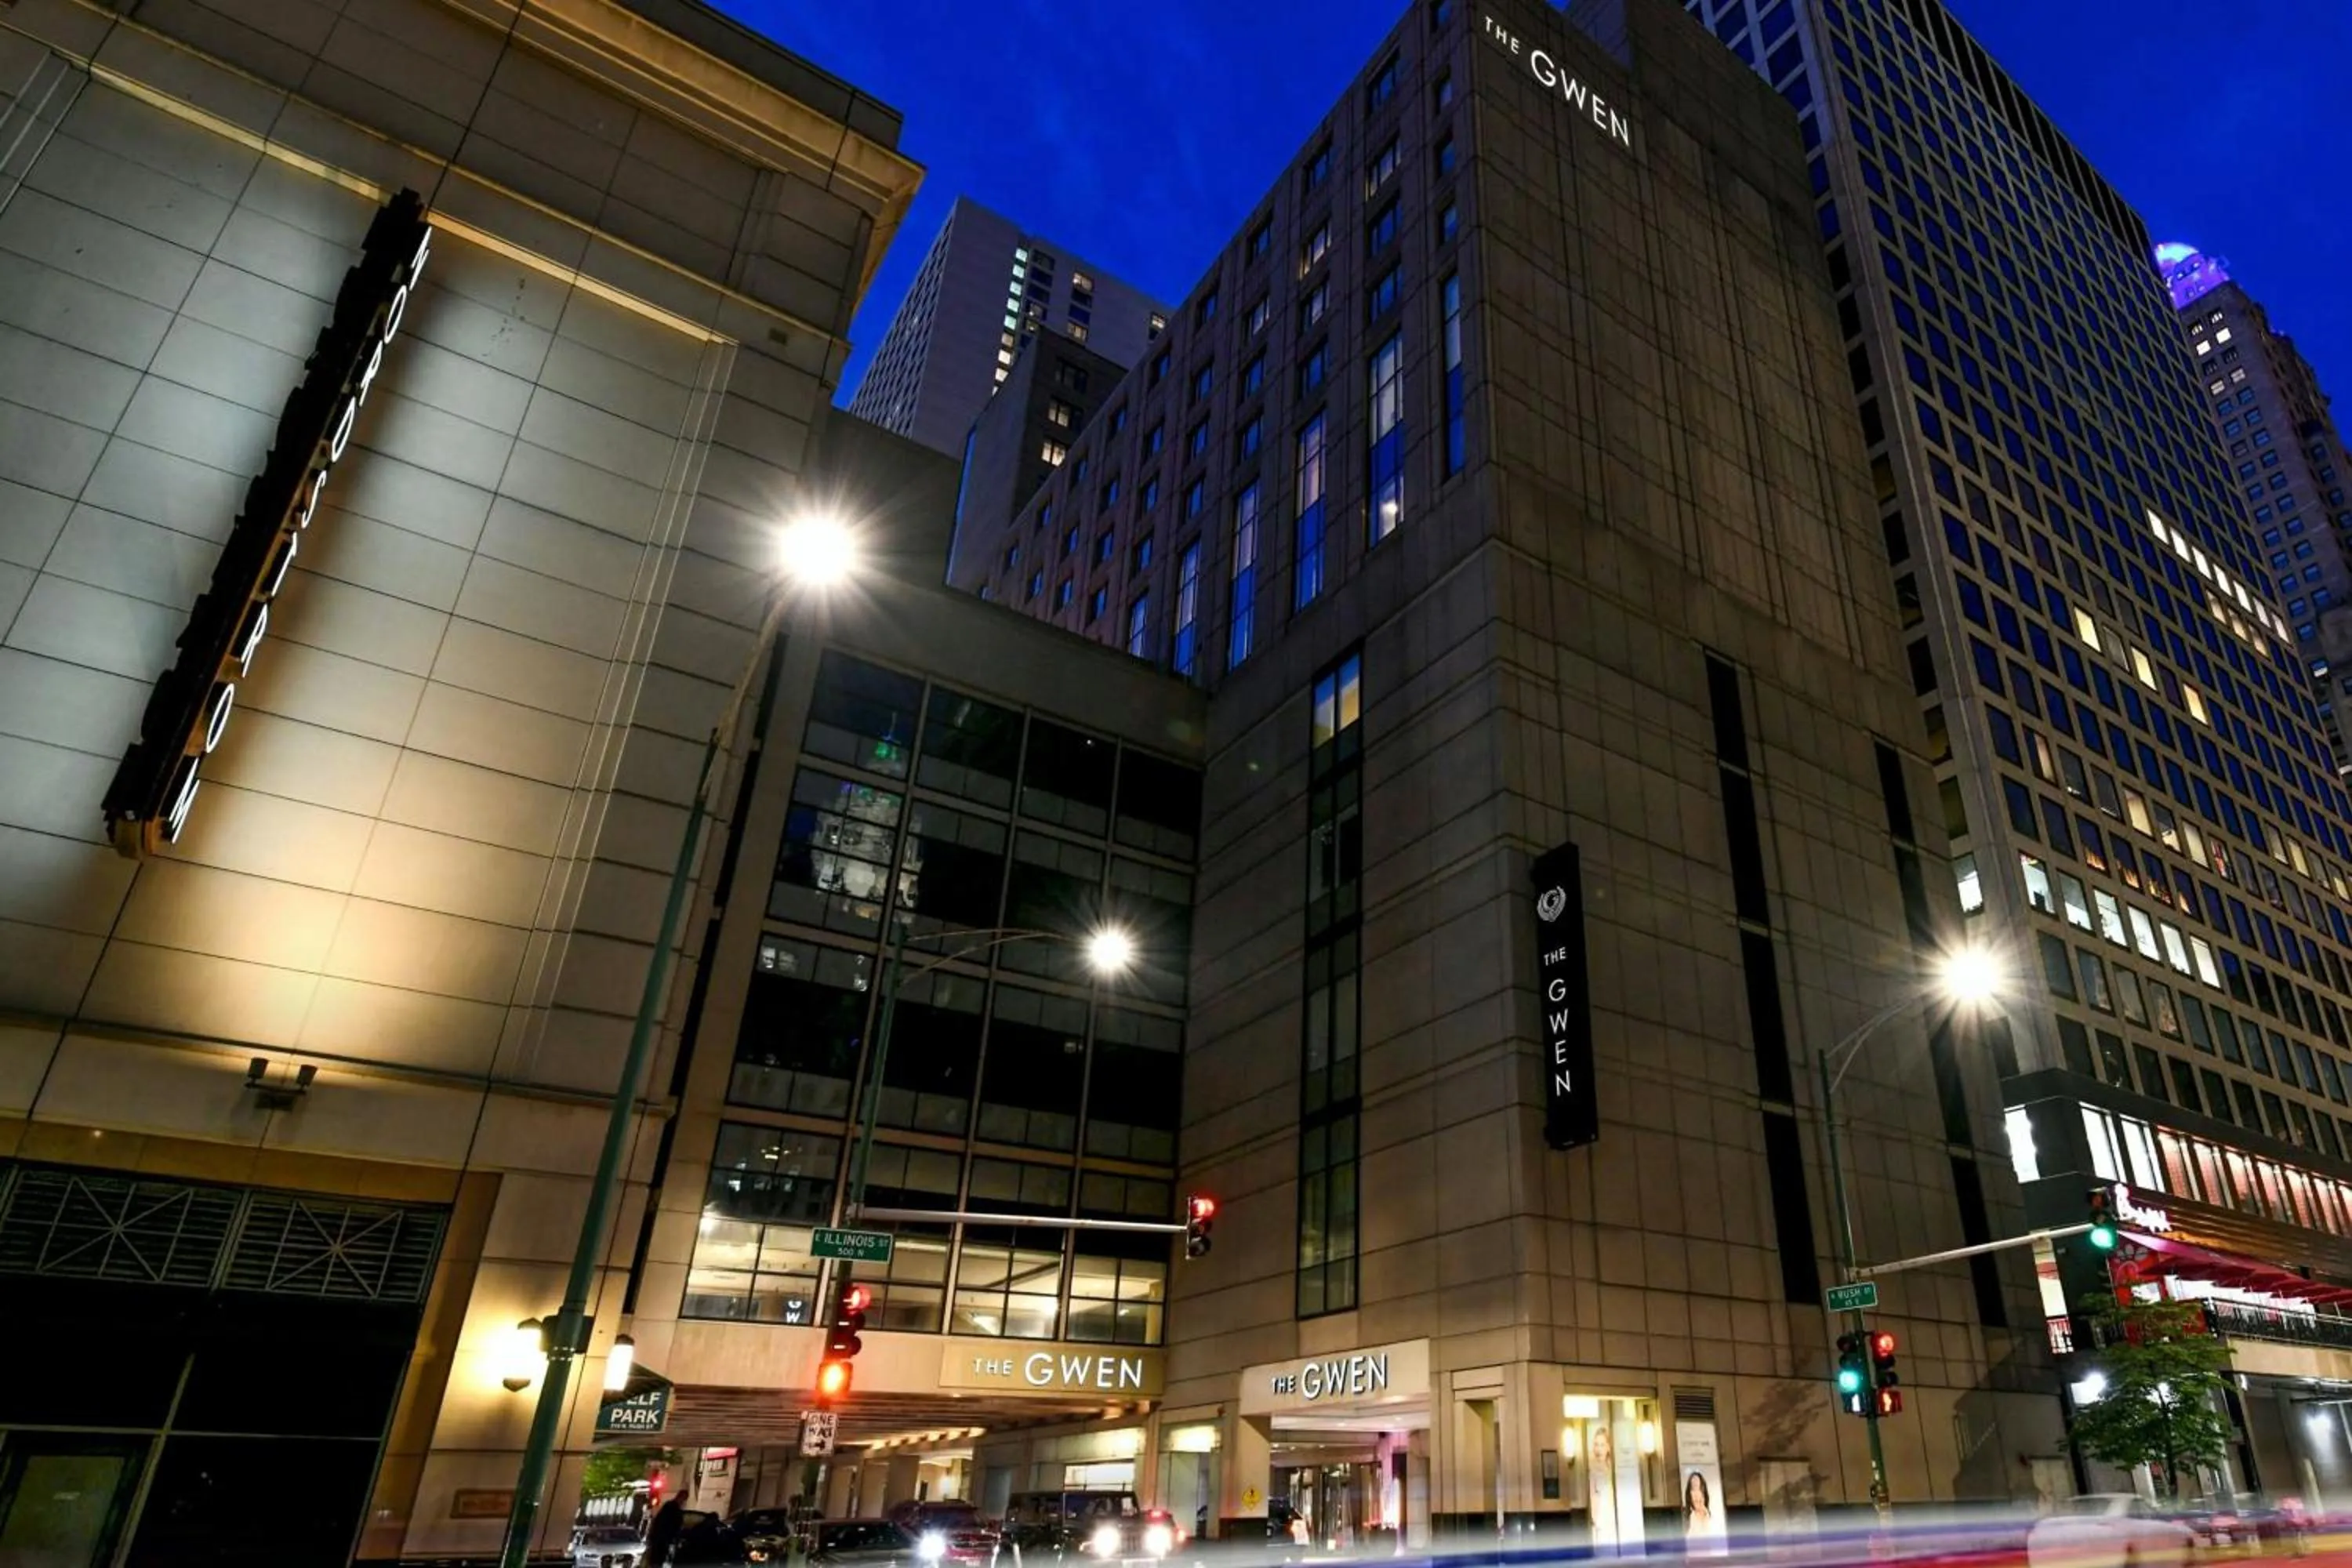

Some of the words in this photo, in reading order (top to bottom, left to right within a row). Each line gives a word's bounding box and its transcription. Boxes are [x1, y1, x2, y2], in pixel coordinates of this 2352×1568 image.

[1485, 16, 1519, 54] THE
[1531, 49, 1629, 147] GWEN
[1543, 946, 1567, 967] THE
[1548, 978, 1571, 1097] GWEN
[824, 1233, 876, 1247] ILLINOIS
[974, 1357, 1014, 1377] THE
[1025, 1352, 1142, 1388] GWEN
[1272, 1374, 1296, 1394] THE
[1301, 1352, 1388, 1400] GWEN
[611, 1407, 662, 1424] PARK
[810, 1414, 834, 1425] ONE
